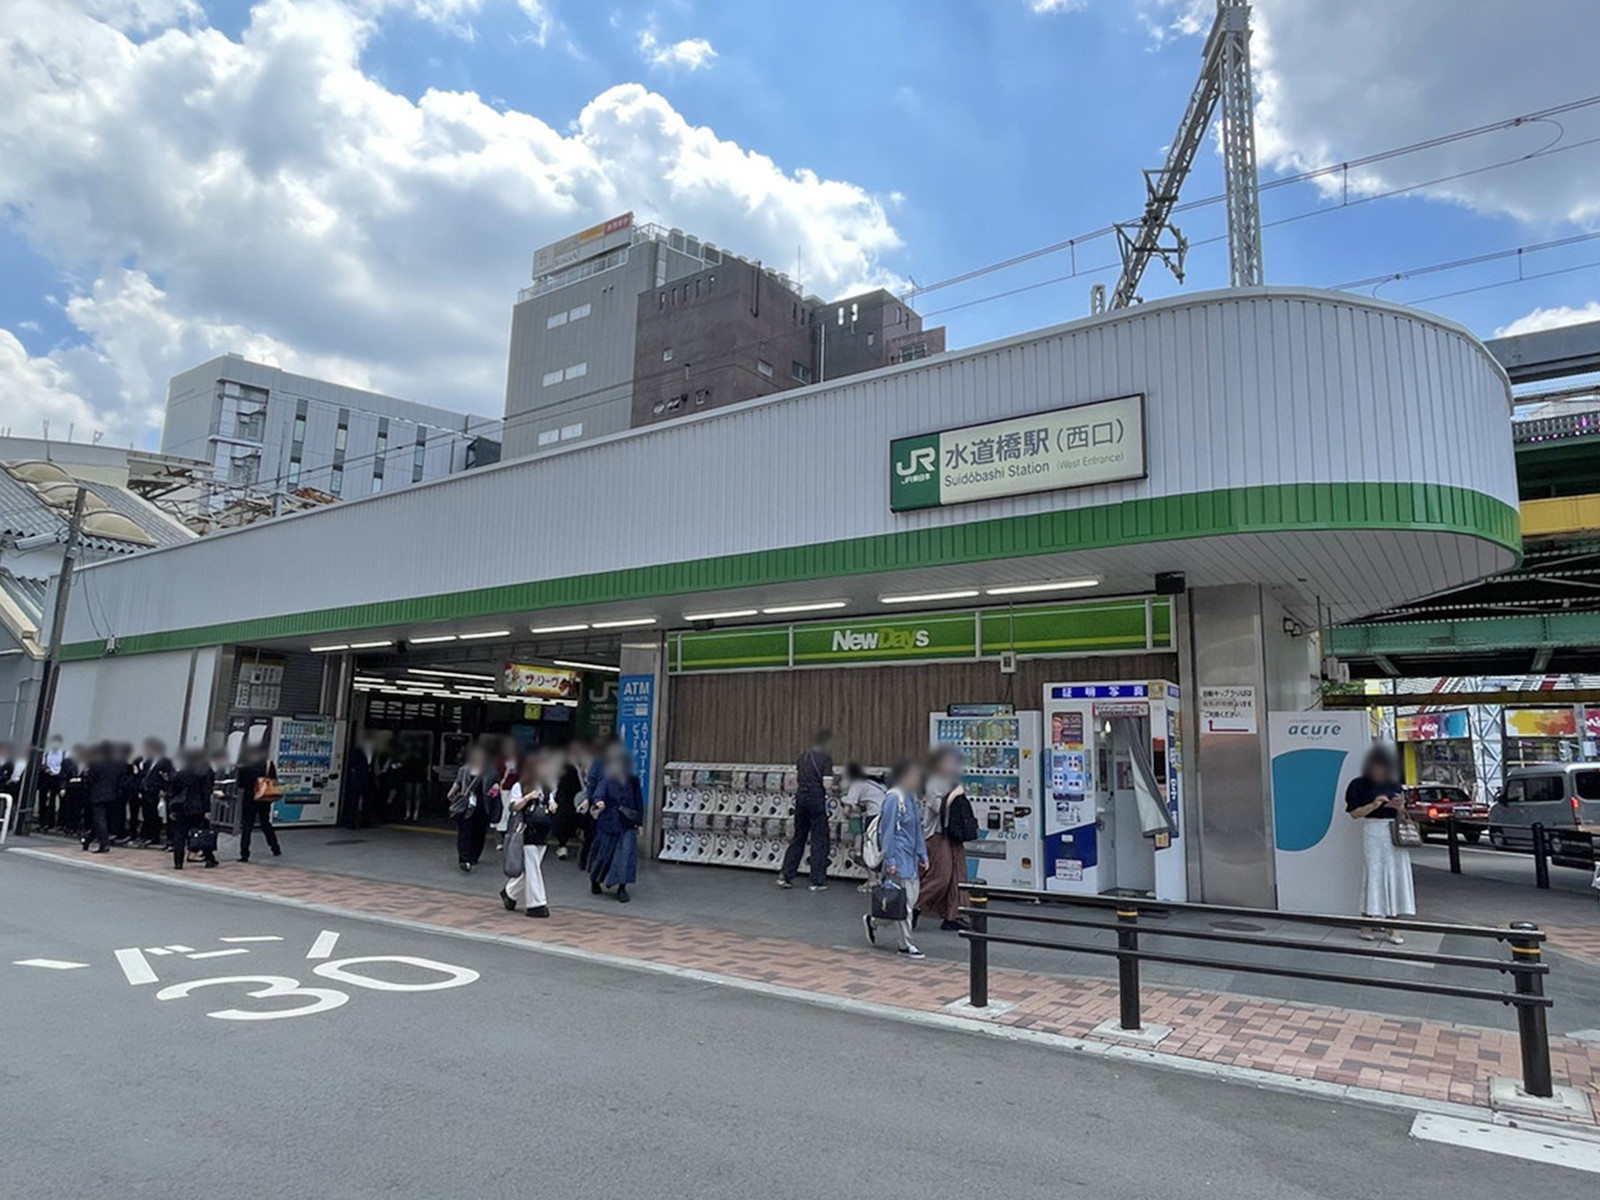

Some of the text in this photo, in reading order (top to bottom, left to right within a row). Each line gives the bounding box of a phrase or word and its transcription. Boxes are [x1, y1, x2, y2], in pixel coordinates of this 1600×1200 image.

[896, 446, 936, 476] JR
[1008, 461, 1051, 478] Station
[832, 627, 930, 652] NewDays
[623, 682, 650, 695] ATM
[1287, 724, 1342, 736] acure
[996, 830, 1030, 841] acure
[155, 955, 480, 1020] 30
